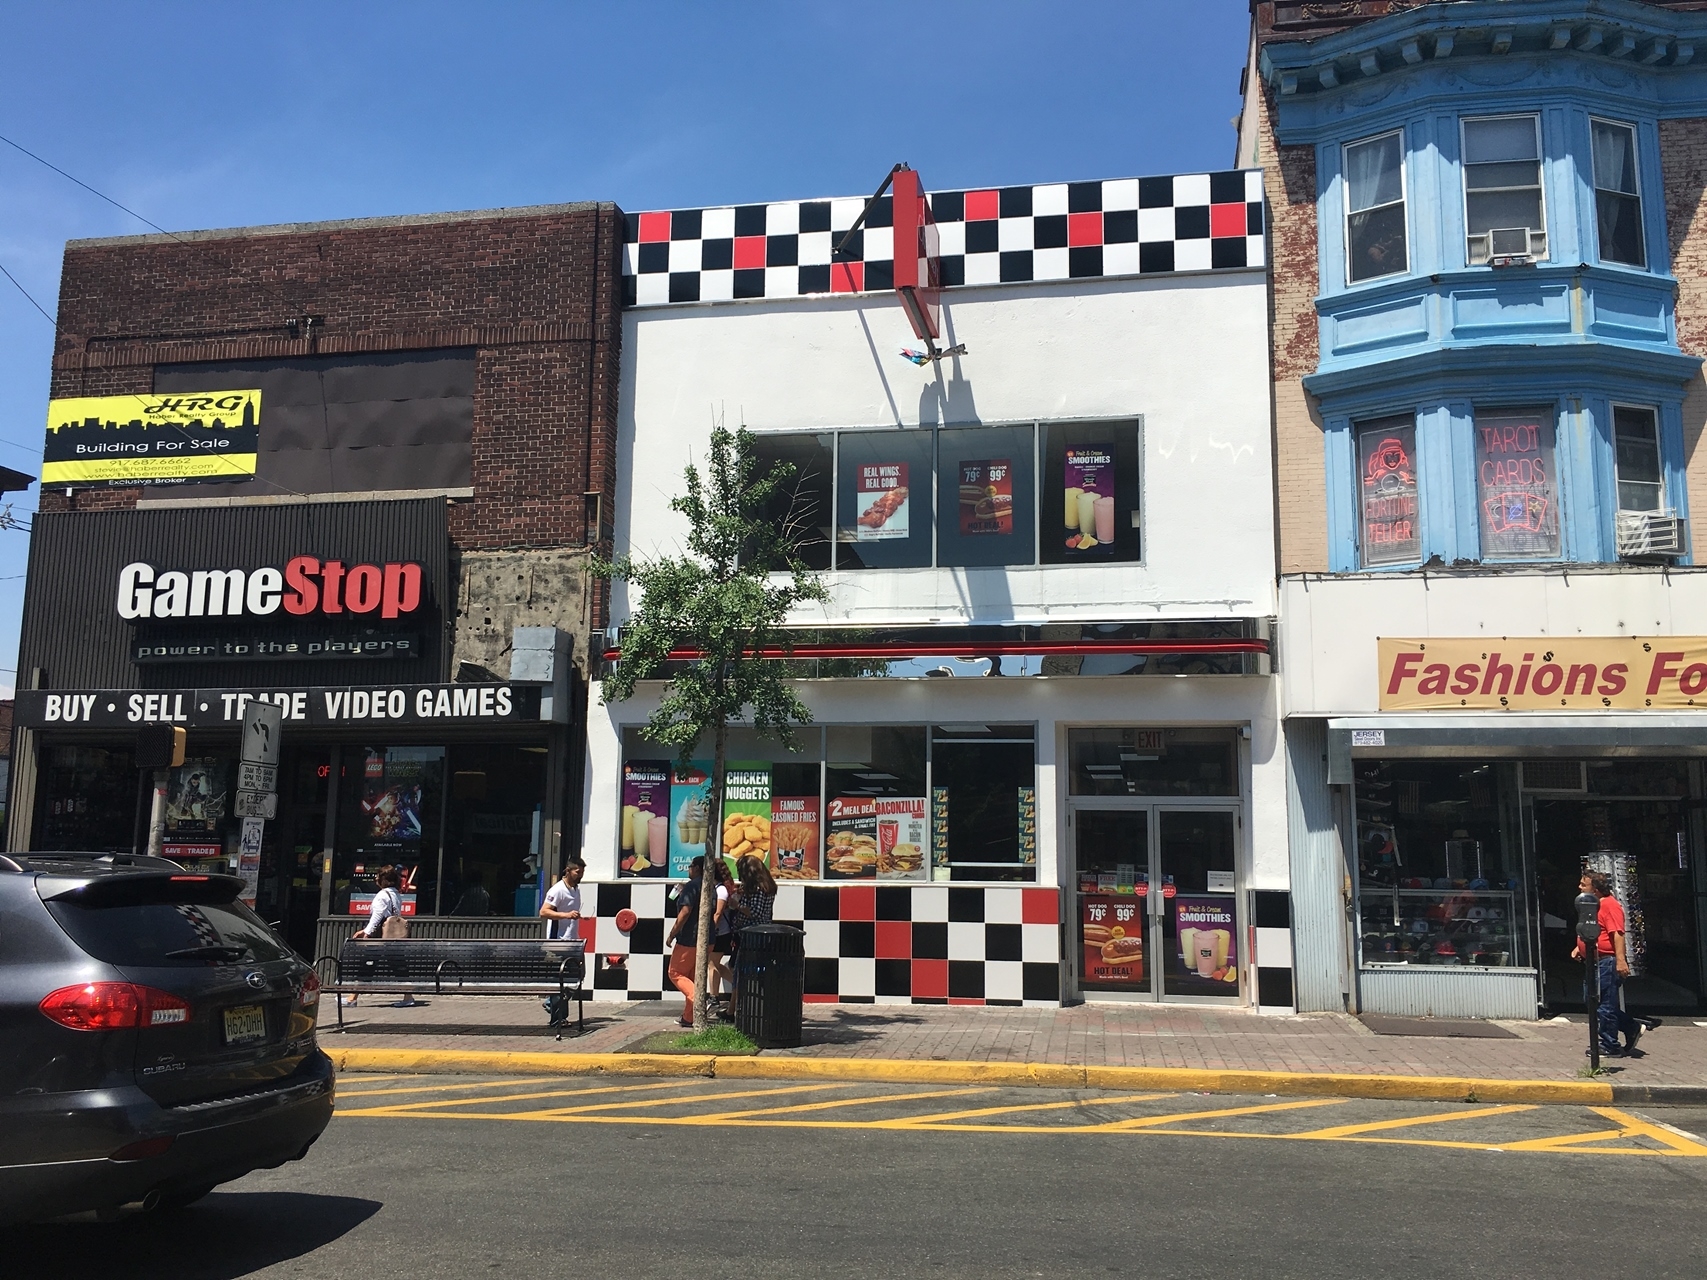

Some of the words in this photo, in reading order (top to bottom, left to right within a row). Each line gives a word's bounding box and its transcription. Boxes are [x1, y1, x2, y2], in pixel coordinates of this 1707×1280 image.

[144, 396, 243, 413] HRG
[76, 442, 149, 454] Building
[156, 440, 185, 450] For
[190, 438, 230, 449] Sale
[1480, 425, 1540, 454] TAROT
[109, 457, 191, 466] 917.687.6662
[1068, 455, 1111, 464] SMOOTHIES
[864, 467, 878, 477] REAL
[879, 466, 901, 476] WINGS.
[965, 471, 980, 482] 79¢
[990, 470, 1005, 481] 99¢
[1481, 457, 1546, 487] CARDS
[865, 478, 880, 488] REAL
[881, 477, 899, 488] GOOD.
[1366, 496, 1415, 519] FORTUNE
[968, 521, 983, 529] HOT
[1368, 521, 1412, 543] TELLER
[117, 554, 422, 620] GameStop
[138, 643, 216, 658] power
[224, 642, 249, 654] to
[257, 640, 299, 654] the
[307, 638, 410, 655] players
[1386, 652, 1629, 696] Fashions
[44, 694, 97, 722] BUY
[127, 694, 188, 722] SELL
[221, 692, 307, 721] TRDE
[325, 690, 406, 720] VIDEO
[416, 686, 513, 718] GAMES
[1138, 731, 1162, 748] EXIT
[367, 763, 383, 771] LEGO
[625, 772, 667, 781] SMOOTHIES
[726, 771, 769, 785] CHICKEN
[725, 786, 770, 800] NUGGETS
[780, 800, 805, 811] FAMOUS
[829, 800, 843, 817] $2
[842, 806, 860, 816] MEAL
[861, 804, 876, 814] DEAL
[876, 799, 925, 815] BACONZILLA!
[799, 811, 817, 822] FRIES
[1089, 908, 1106, 921] 79¢
[1116, 908, 1134, 921] 99¢
[1188, 905, 1200, 913] Fruit
[1179, 912, 1232, 923] SMOOTHIES
[1094, 967, 1111, 975] HOT
[1112, 967, 1133, 975] DEAL!
[143, 1062, 186, 1075] SUBARU
